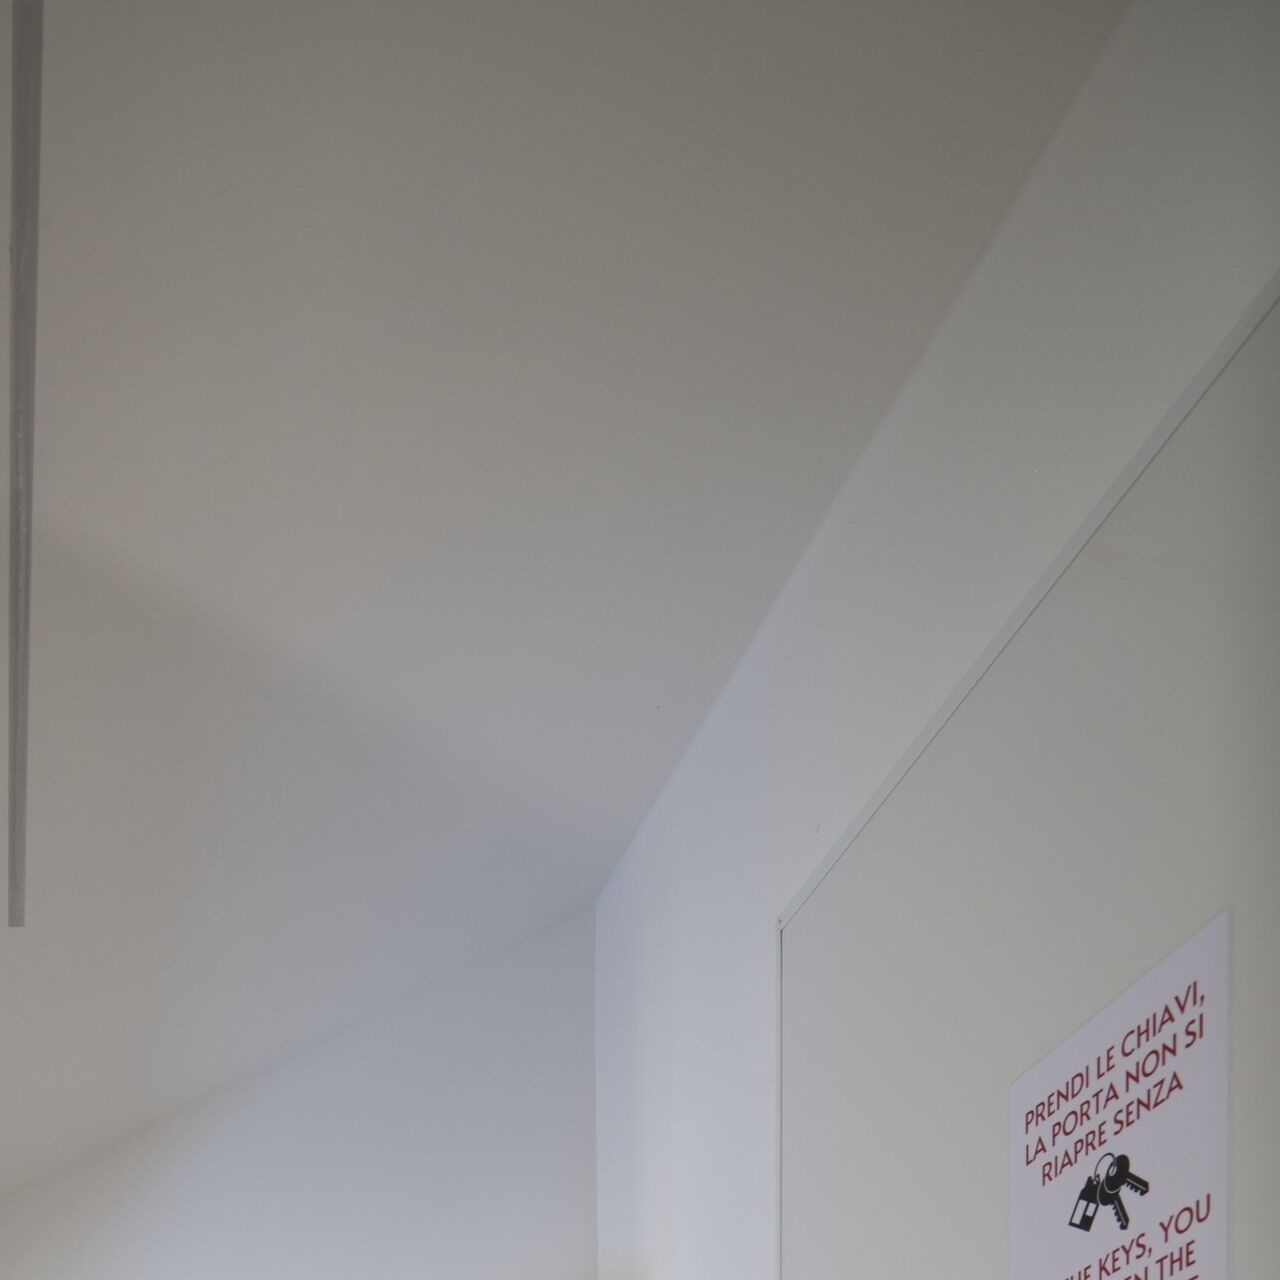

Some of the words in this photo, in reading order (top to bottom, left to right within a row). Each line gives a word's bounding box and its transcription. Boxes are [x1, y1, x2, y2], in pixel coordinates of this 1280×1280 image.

[1025, 1066, 1089, 1134] PRENDI
[1097, 1045, 1115, 1080] LE
[1121, 980, 1205, 1057] CHIAVI,
[1026, 1136, 1046, 1166] LA
[1052, 1082, 1119, 1146] PORTA
[1125, 1033, 1177, 1093] NON
[1185, 1013, 1204, 1048] SI
[1042, 1121, 1107, 1186] RIAPRE
[1114, 1071, 1184, 1135] SENZA
[1099, 1233, 1152, 1280] KEYS,
[1159, 1193, 1211, 1243] YOU
